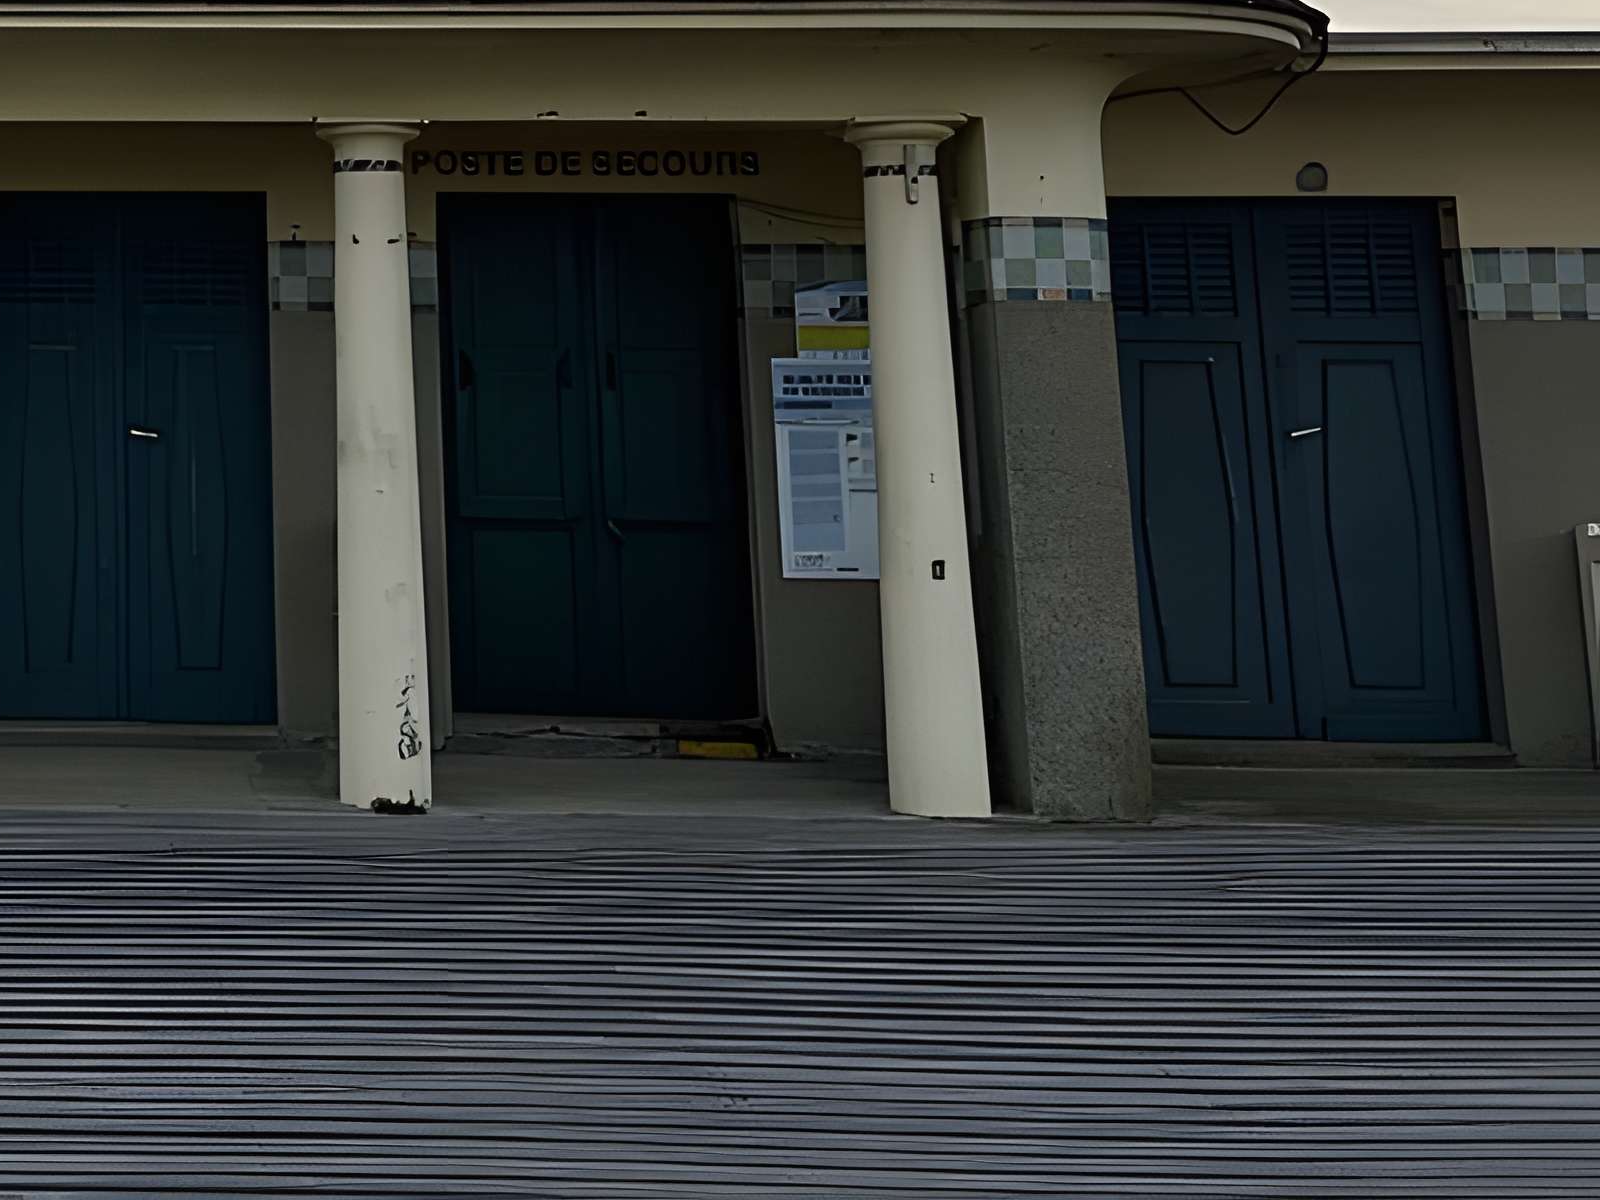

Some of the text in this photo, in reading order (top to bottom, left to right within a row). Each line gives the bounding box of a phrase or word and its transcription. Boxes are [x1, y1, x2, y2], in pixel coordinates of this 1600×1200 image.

[410, 150, 761, 177] POSTE DE SECOURS
